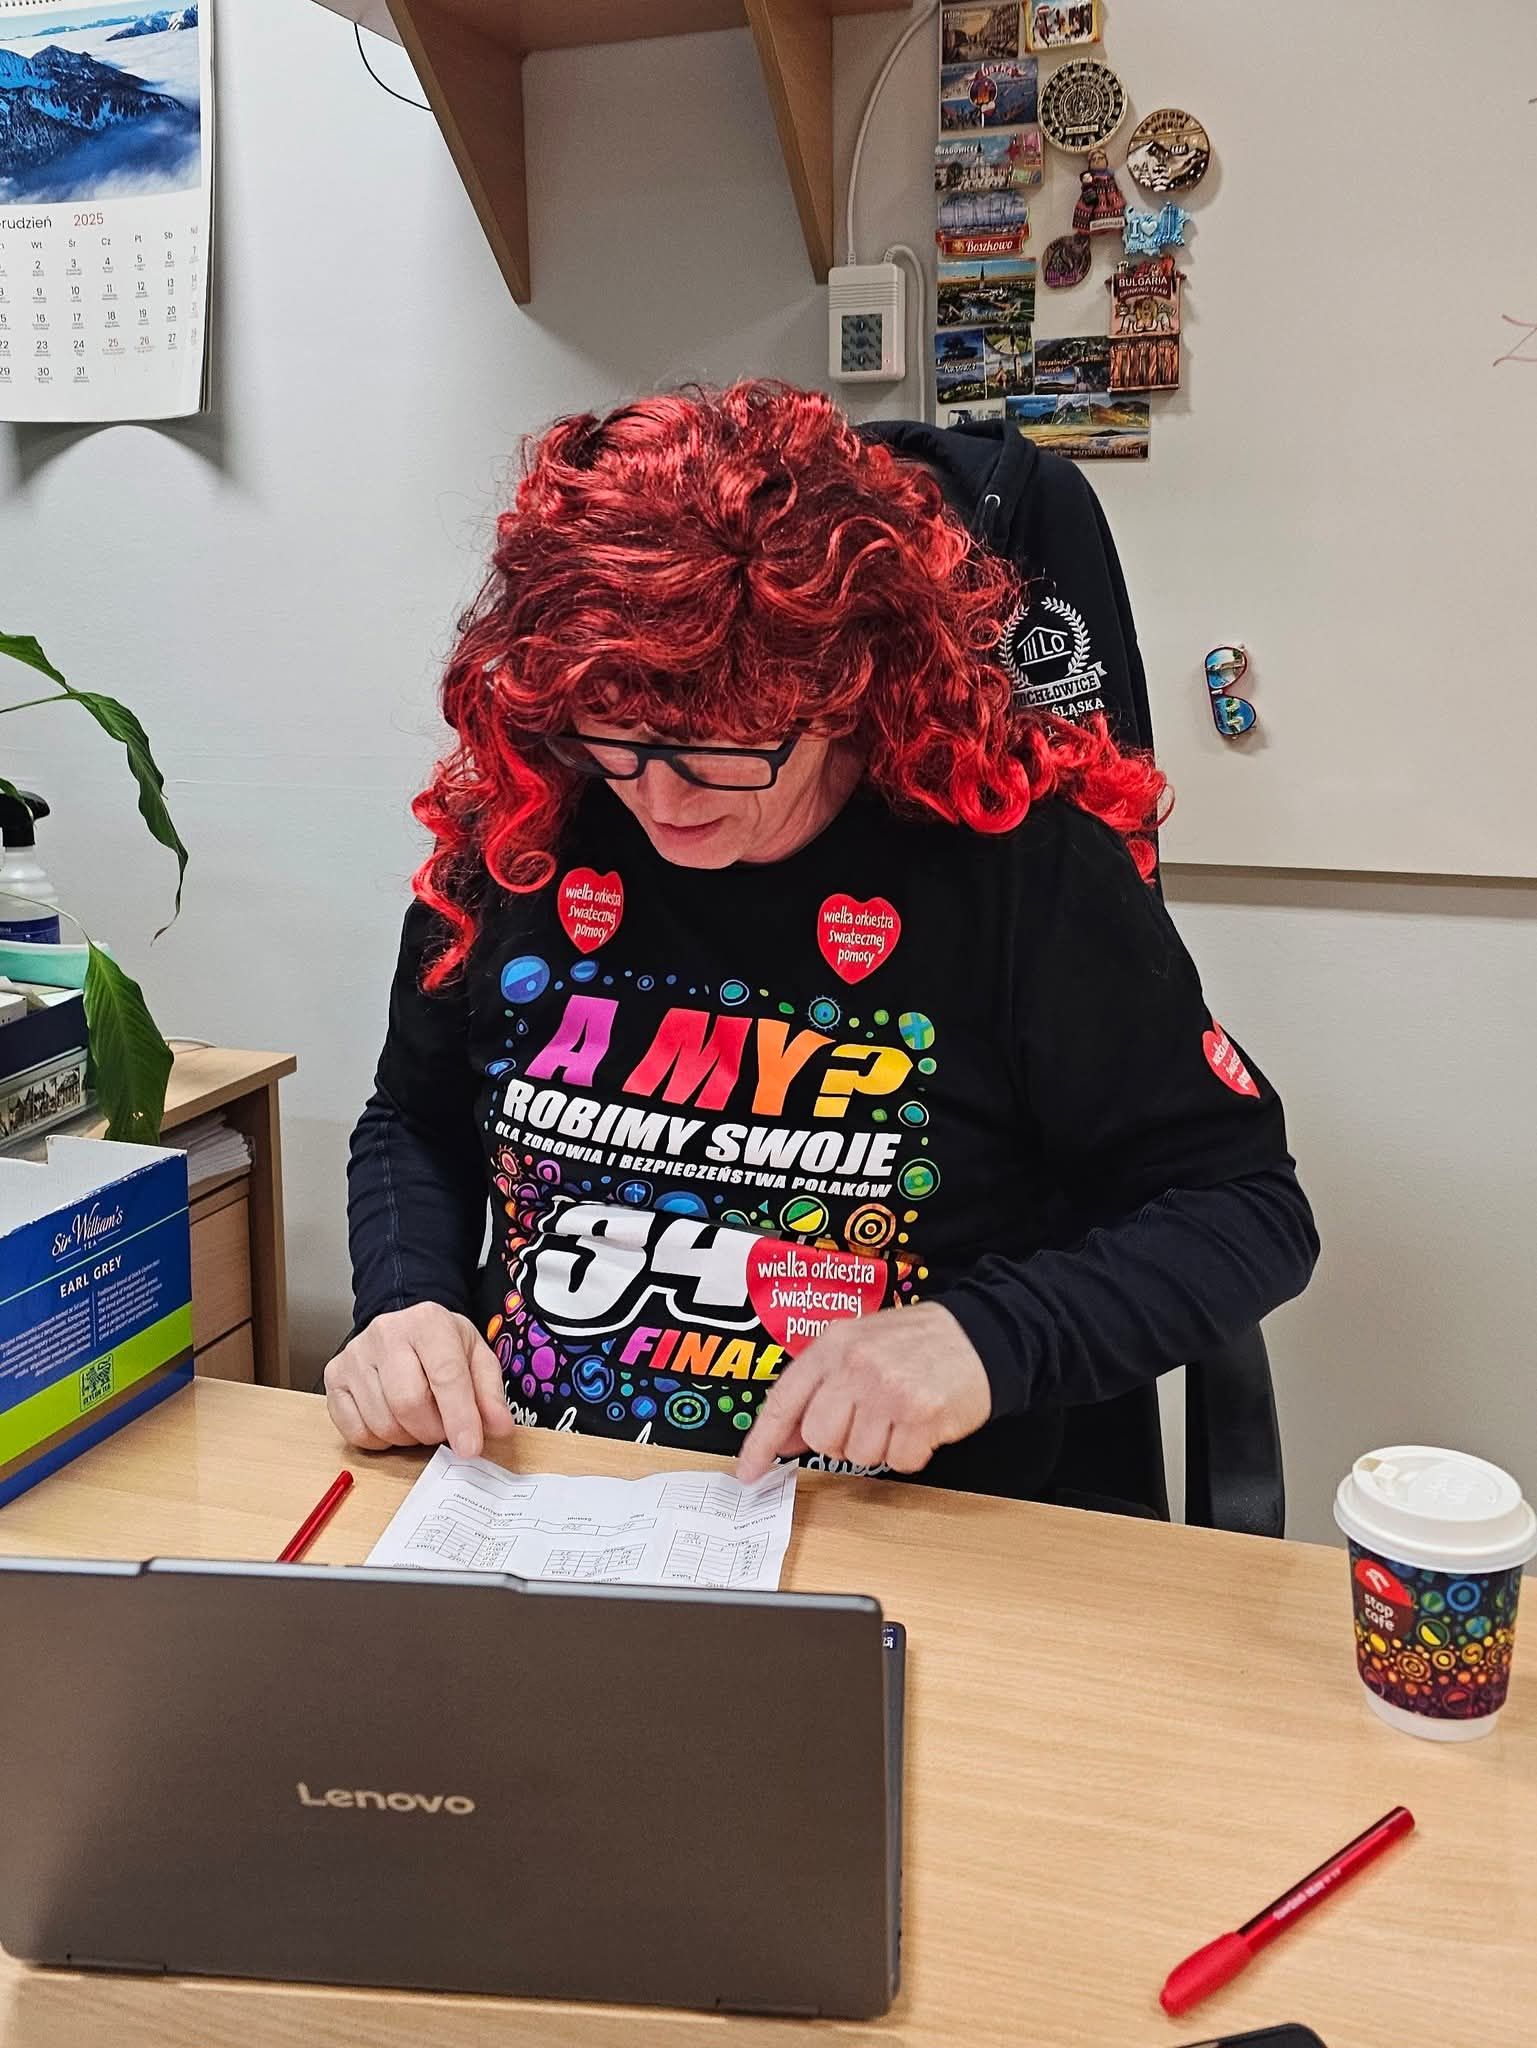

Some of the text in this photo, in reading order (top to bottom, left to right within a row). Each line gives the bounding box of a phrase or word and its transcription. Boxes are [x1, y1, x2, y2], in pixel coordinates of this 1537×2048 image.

[0, 212, 104, 230] rudzień 2025
[31, 241, 42, 249] Wt
[101, 237, 111, 246] Cz
[135, 234, 142, 243] Pt
[965, 239, 1013, 253] Boszkowo
[35, 260, 41, 269] 2
[71, 258, 76, 268] 3
[105, 256, 111, 266] 4
[137, 254, 142, 263] 5
[167, 251, 172, 260] 6
[37, 287, 42, 296] 9
[71, 286, 80, 295] 10
[107, 284, 113, 293] 11
[137, 281, 145, 291] 12
[167, 278, 174, 287] 13
[1119, 275, 1168, 287] BULGARIA
[1150, 286, 1168, 295] TEAM
[36, 313, 46, 323] 16
[73, 313, 81, 322] 17
[107, 311, 116, 321] 18
[139, 309, 147, 319] 19
[167, 306, 176, 315] 20
[36, 341, 48, 350] 23
[73, 340, 84, 349] 24
[108, 338, 119, 348] 25
[139, 336, 150, 346] 26
[168, 333, 176, 343] 27
[37, 367, 50, 376] 30
[76, 366, 85, 376] 31
[1051, 697, 1105, 717] ŚLĄSKA
[566, 883, 593, 901] wielka
[568, 900, 617, 931] świątecznej
[823, 905, 894, 929] wielka orkiestra
[574, 922, 608, 945] pomocy
[828, 925, 886, 955] świątecznej
[837, 948, 876, 969] pomocy
[524, 995, 914, 1117] A MY?
[502, 1079, 901, 1178] ROBIMY SWOJE
[522, 1128, 602, 1165] ZDROWIA
[606, 1151, 616, 1166] I
[619, 1154, 788, 1190] BEZPIECZEŃSTWA
[793, 1176, 894, 1199] POLAKÓW
[51, 1202, 124, 1257] Sir William's
[533, 1203, 763, 1320] 34
[757, 1250, 875, 1285] wielka orkiestra
[60, 1255, 122, 1299] EARL GREY
[769, 1281, 862, 1321] świątecznej
[619, 1327, 785, 1381] FINAŁ
[1364, 1593, 1394, 1619] stop
[1365, 1607, 1395, 1632] cafe
[295, 1781, 476, 1815] Lenovo
